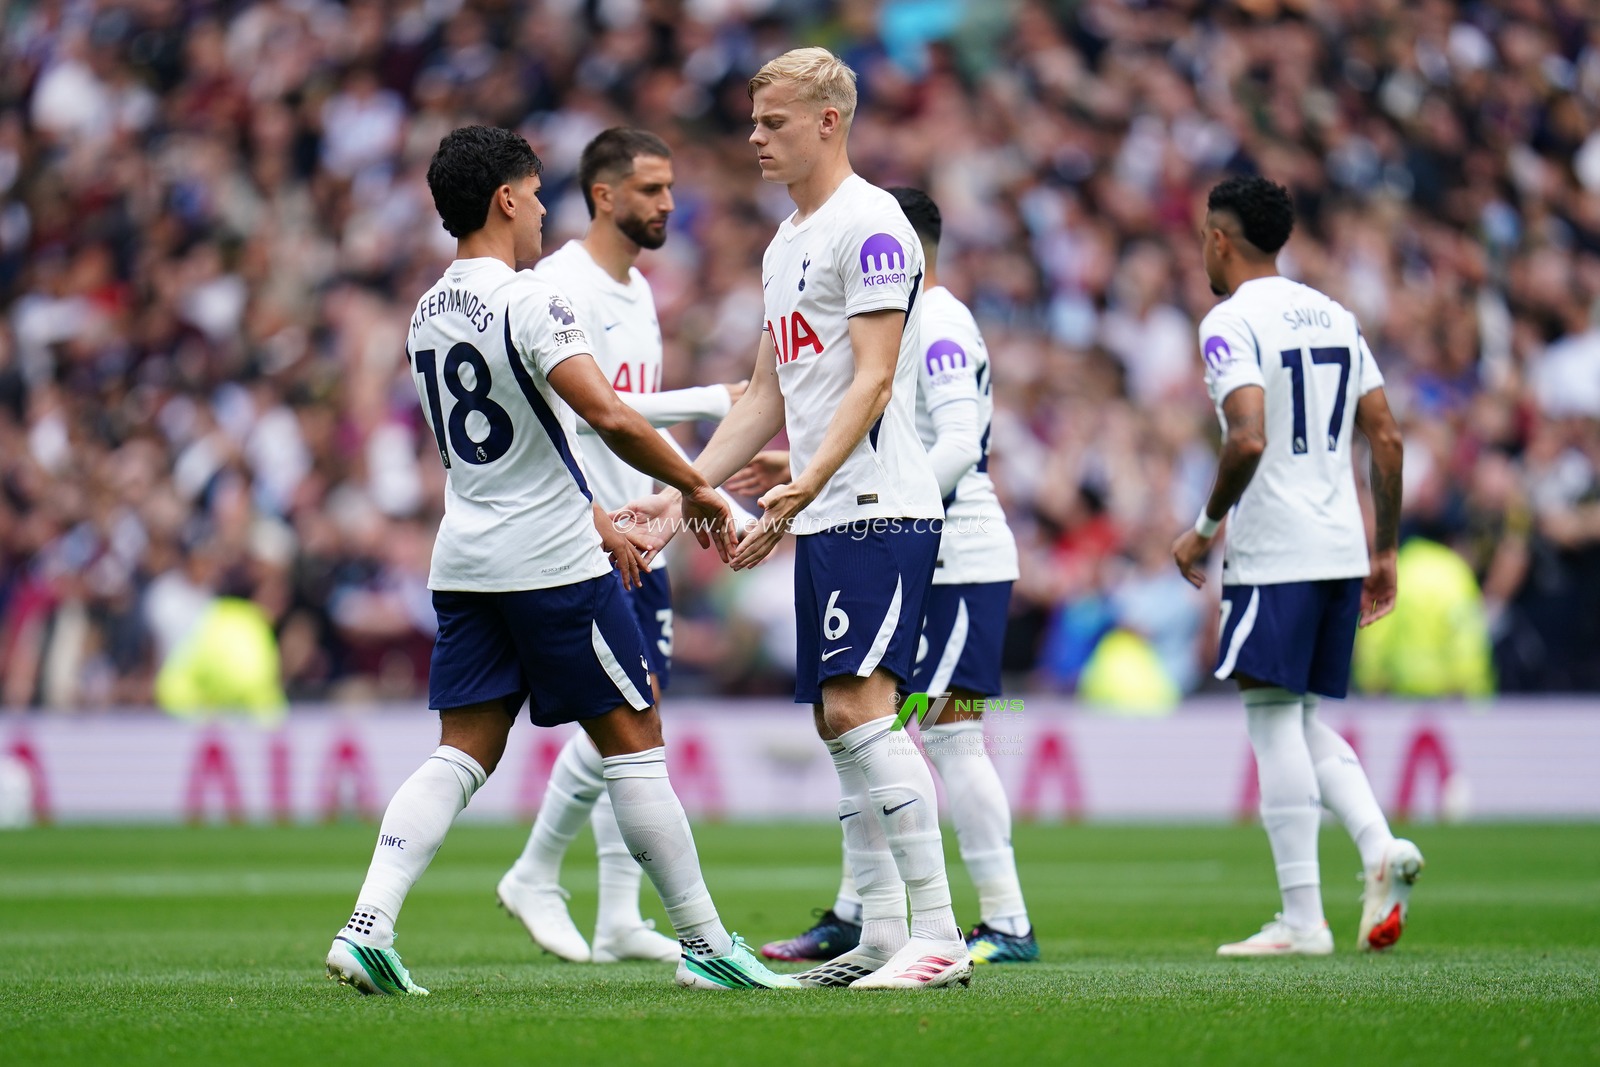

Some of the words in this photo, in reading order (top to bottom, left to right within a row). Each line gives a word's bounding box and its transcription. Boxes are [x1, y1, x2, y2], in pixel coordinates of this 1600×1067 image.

[863, 272, 906, 288] kraken
[412, 288, 494, 338] M.FERNANDES
[415, 341, 514, 469] 18
[1280, 346, 1351, 454] 17
[823, 590, 849, 641] 6
[380, 834, 407, 850] THFC
